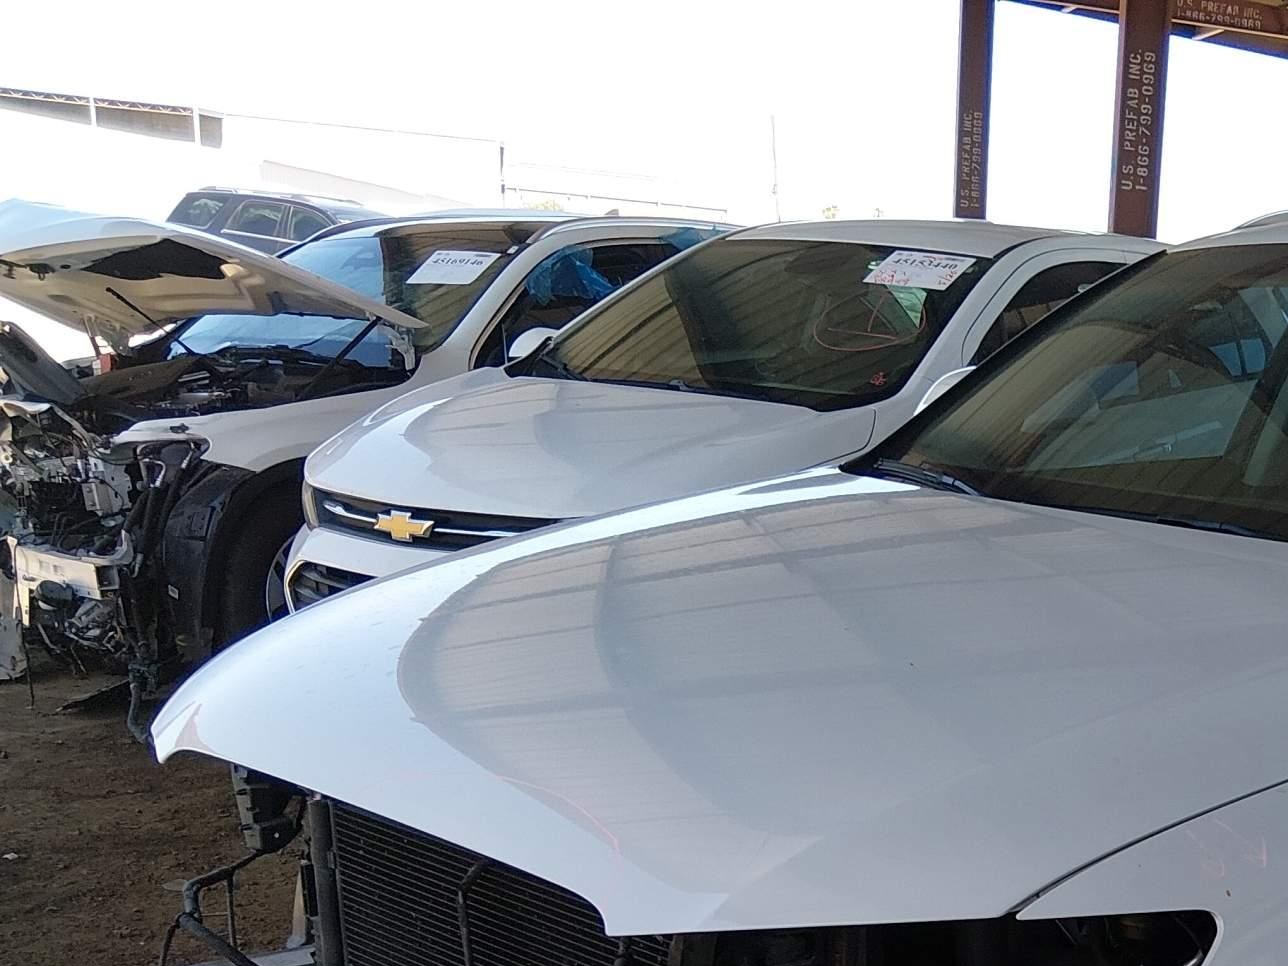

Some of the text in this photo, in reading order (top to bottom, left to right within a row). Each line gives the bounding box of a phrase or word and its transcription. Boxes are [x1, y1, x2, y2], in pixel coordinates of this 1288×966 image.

[1121, 49, 1142, 191] U.S. PREFAB INC.
[1135, 52, 1156, 191] 1-866-799-0969
